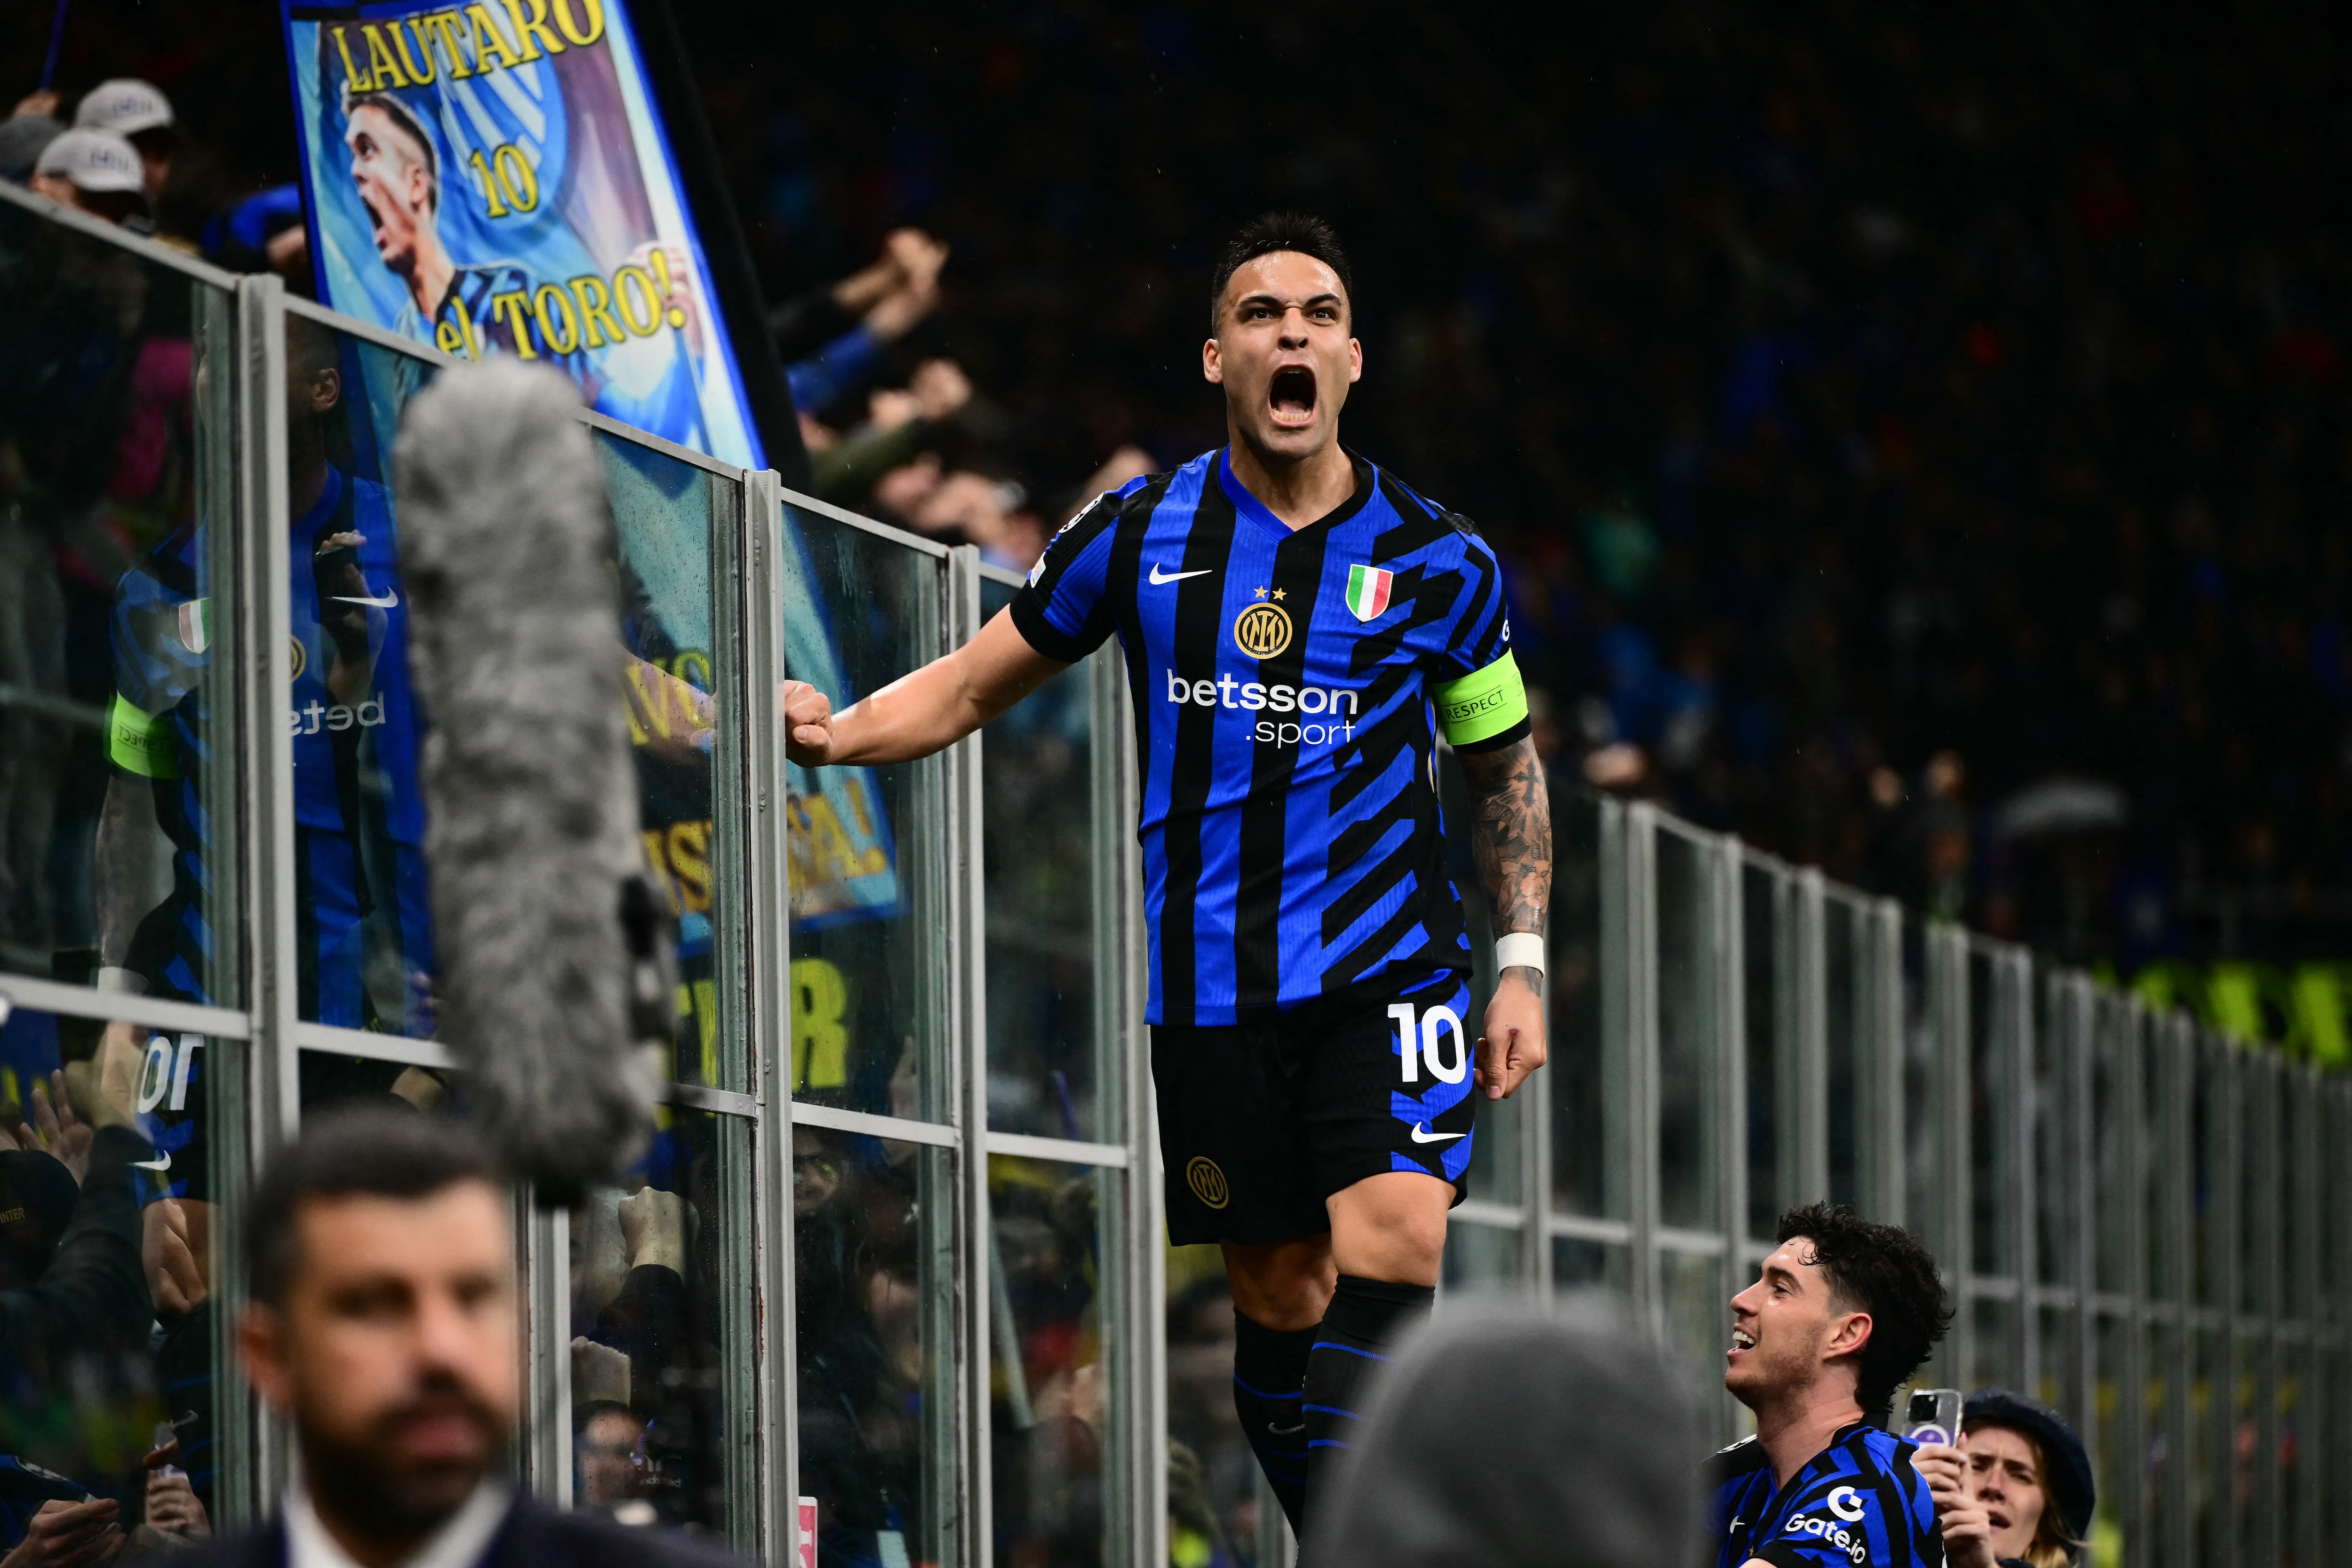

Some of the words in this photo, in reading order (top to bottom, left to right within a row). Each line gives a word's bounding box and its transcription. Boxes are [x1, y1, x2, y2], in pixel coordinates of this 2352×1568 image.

[331, 0, 605, 93] LAUTARO
[471, 145, 538, 218] 10
[493, 248, 686, 360] TORO!
[1167, 669, 1359, 715] betsson
[1445, 689, 1504, 720] RESPECT
[1246, 720, 1356, 749] .sport
[1387, 1003, 1467, 1084] 10
[1785, 1513, 1866, 1564] Gate.io
